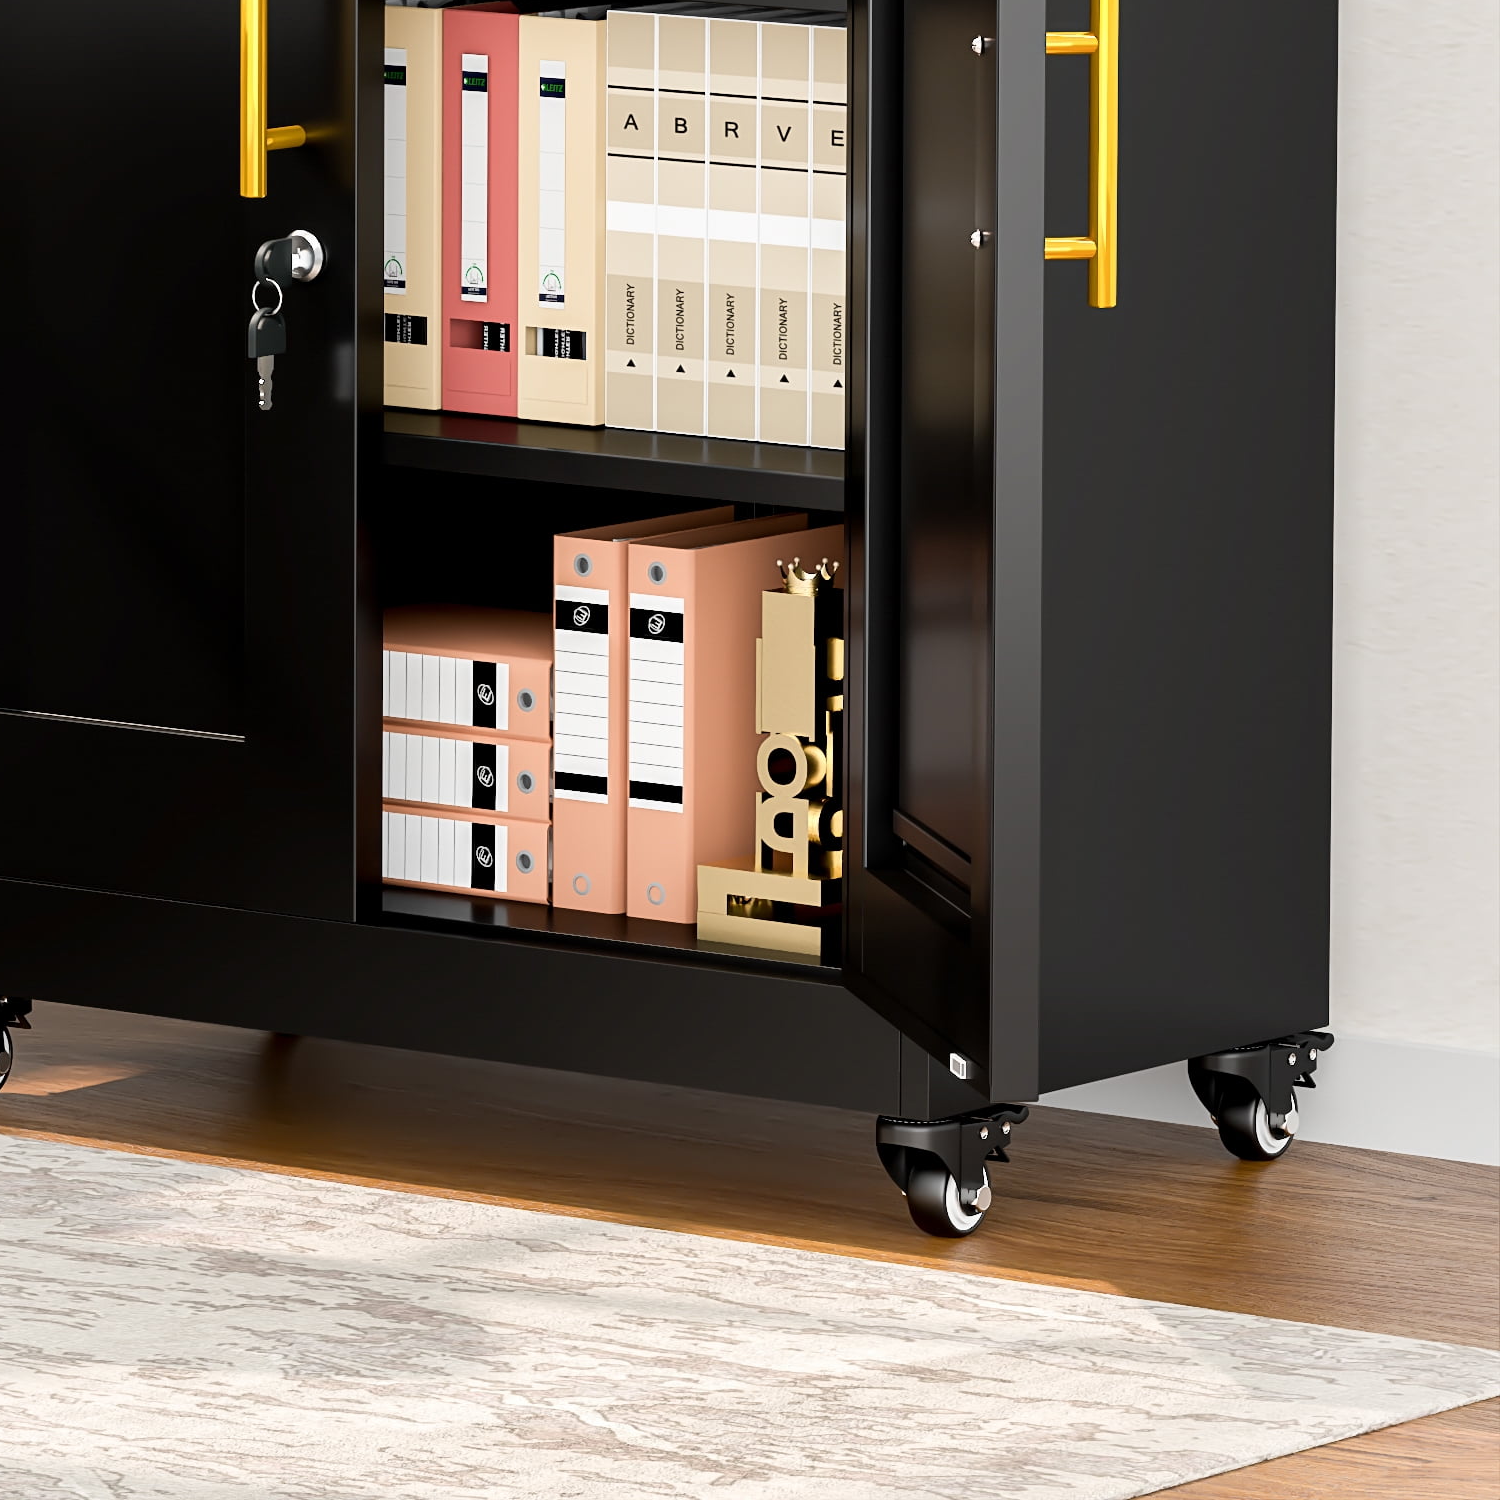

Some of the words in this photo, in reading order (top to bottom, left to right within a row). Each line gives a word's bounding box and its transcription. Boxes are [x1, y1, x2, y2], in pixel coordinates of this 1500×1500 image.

[468, 77, 485, 87] LEITZ
[546, 83, 563, 93] LEITZ
[624, 114, 639, 131] A
[674, 117, 688, 134] B
[724, 121, 739, 139] R
[776, 125, 792, 142] V
[831, 129, 845, 147] E
[626, 283, 636, 345] DICTIONARY
[675, 288, 685, 350] DICTIONARY
[725, 293, 735, 356] DICTIONARY
[778, 298, 788, 361] DICTIONARY
[832, 303, 843, 366] DICTIONARY
